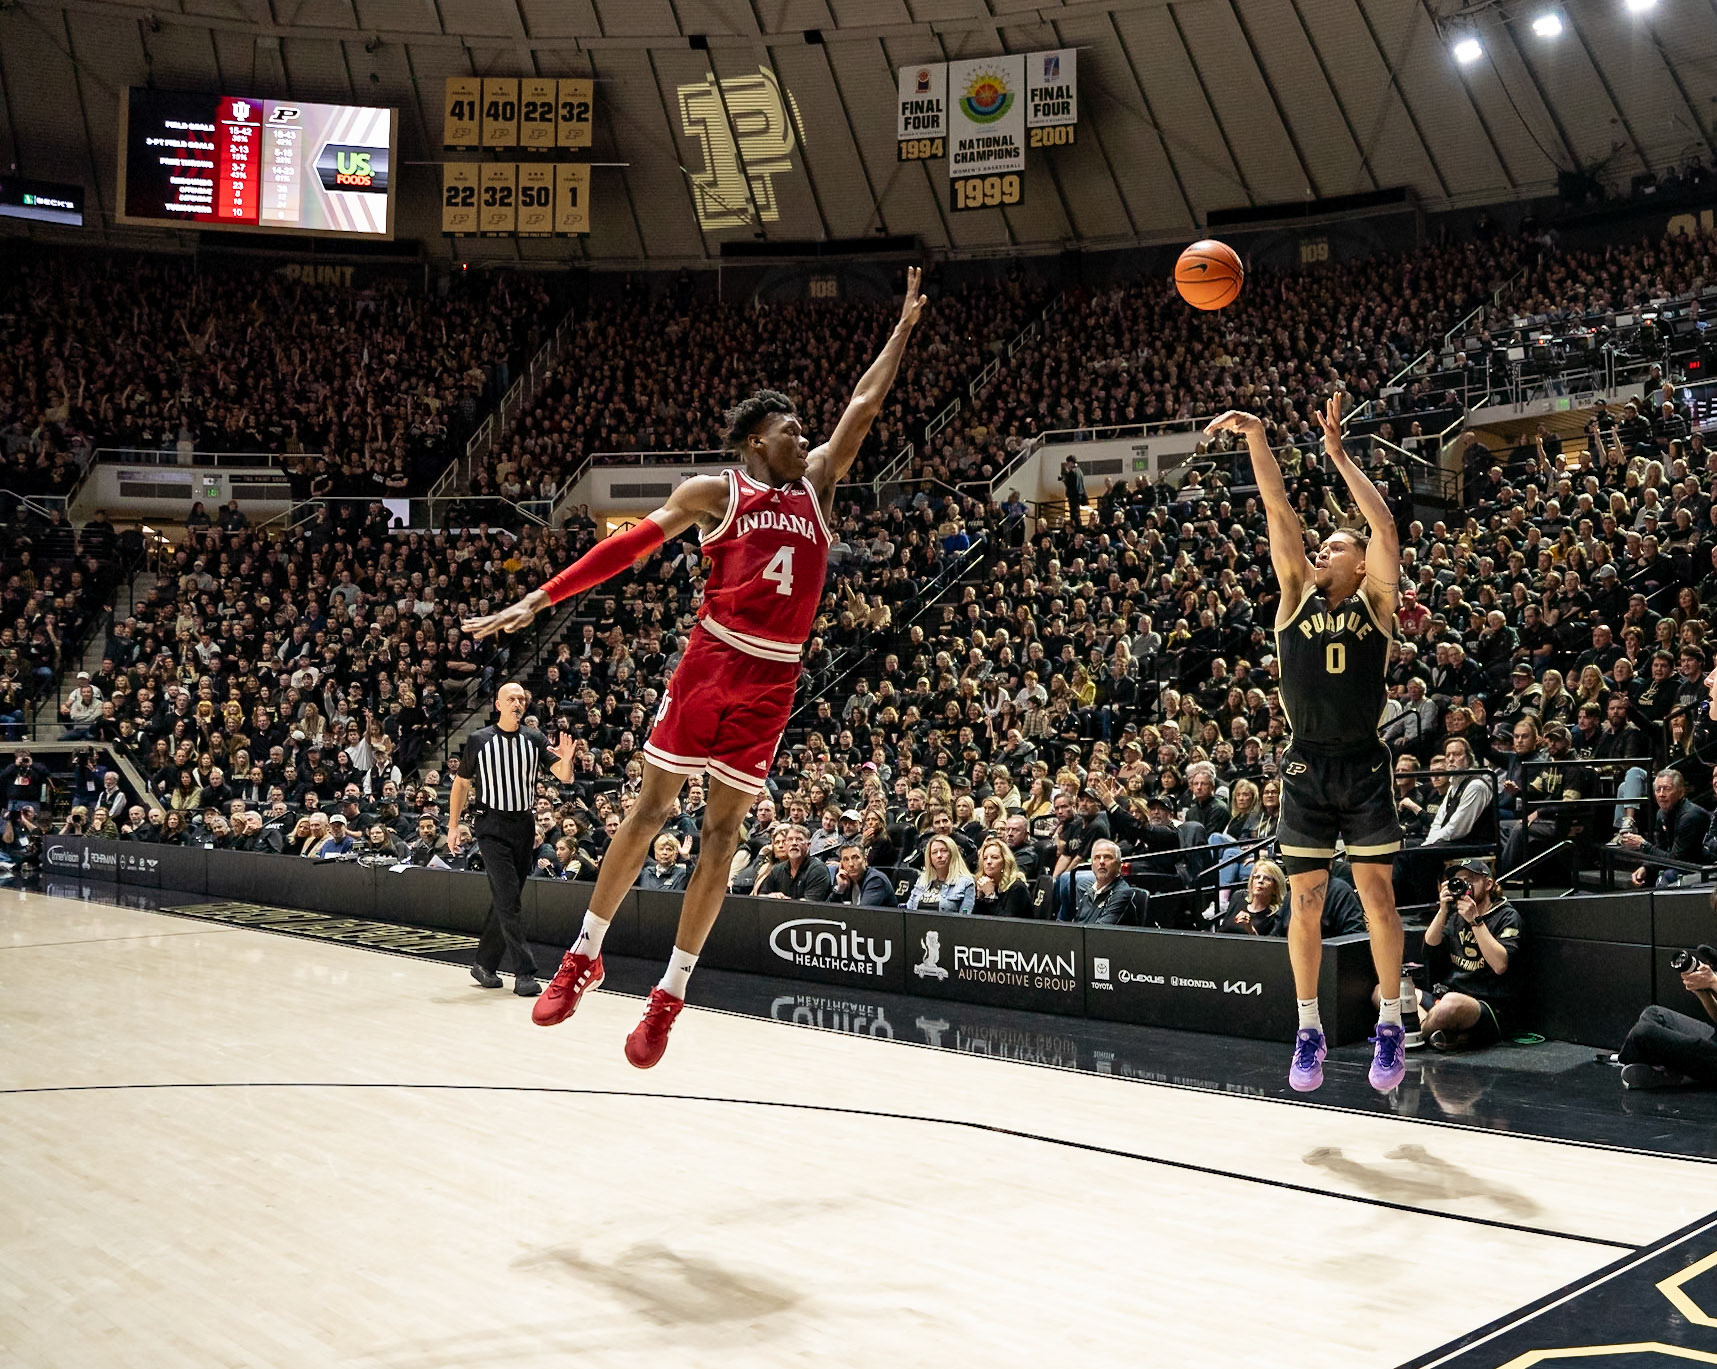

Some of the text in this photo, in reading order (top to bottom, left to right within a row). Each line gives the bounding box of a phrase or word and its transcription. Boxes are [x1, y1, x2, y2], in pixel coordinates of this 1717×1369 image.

[1031, 85, 1073, 102] FINAL
[450, 101, 475, 121] 41
[486, 101, 515, 121] 40
[524, 101, 553, 122] 22
[561, 101, 590, 122] 32
[902, 99, 943, 115] FINAL
[1033, 100, 1071, 118] FOUR
[904, 114, 941, 131] FOUR
[959, 135, 1014, 151] NATIONAL
[1030, 126, 1075, 148] 2001
[900, 139, 944, 160] 1994
[954, 147, 1020, 164] CHAMPIONS
[953, 163, 1021, 175] WOMEN'S BASKETBALL
[336, 174, 371, 186] FOODS
[446, 186, 475, 207] 22
[484, 186, 512, 207] 32
[521, 186, 551, 207] 50
[569, 187, 577, 207] 1
[955, 174, 1020, 209] 1999
[232, 208, 243, 216] 10
[1301, 243, 1328, 263] 109
[735, 510, 817, 545] INDIANA
[762, 545, 796, 596] 4
[1298, 611, 1373, 641] PURDUE
[1326, 642, 1346, 674] 0
[1286, 761, 1307, 776] P
[790, 929, 892, 976] unity
[954, 945, 1076, 978] ROHRMAN
[795, 953, 873, 976] HEALTHCARE
[958, 967, 1076, 992] AUTOMOTIVE GROUP
[1091, 982, 1113, 991] TOYOTA
[1130, 973, 1165, 985] LEXUS
[1179, 978, 1217, 990] HONDA
